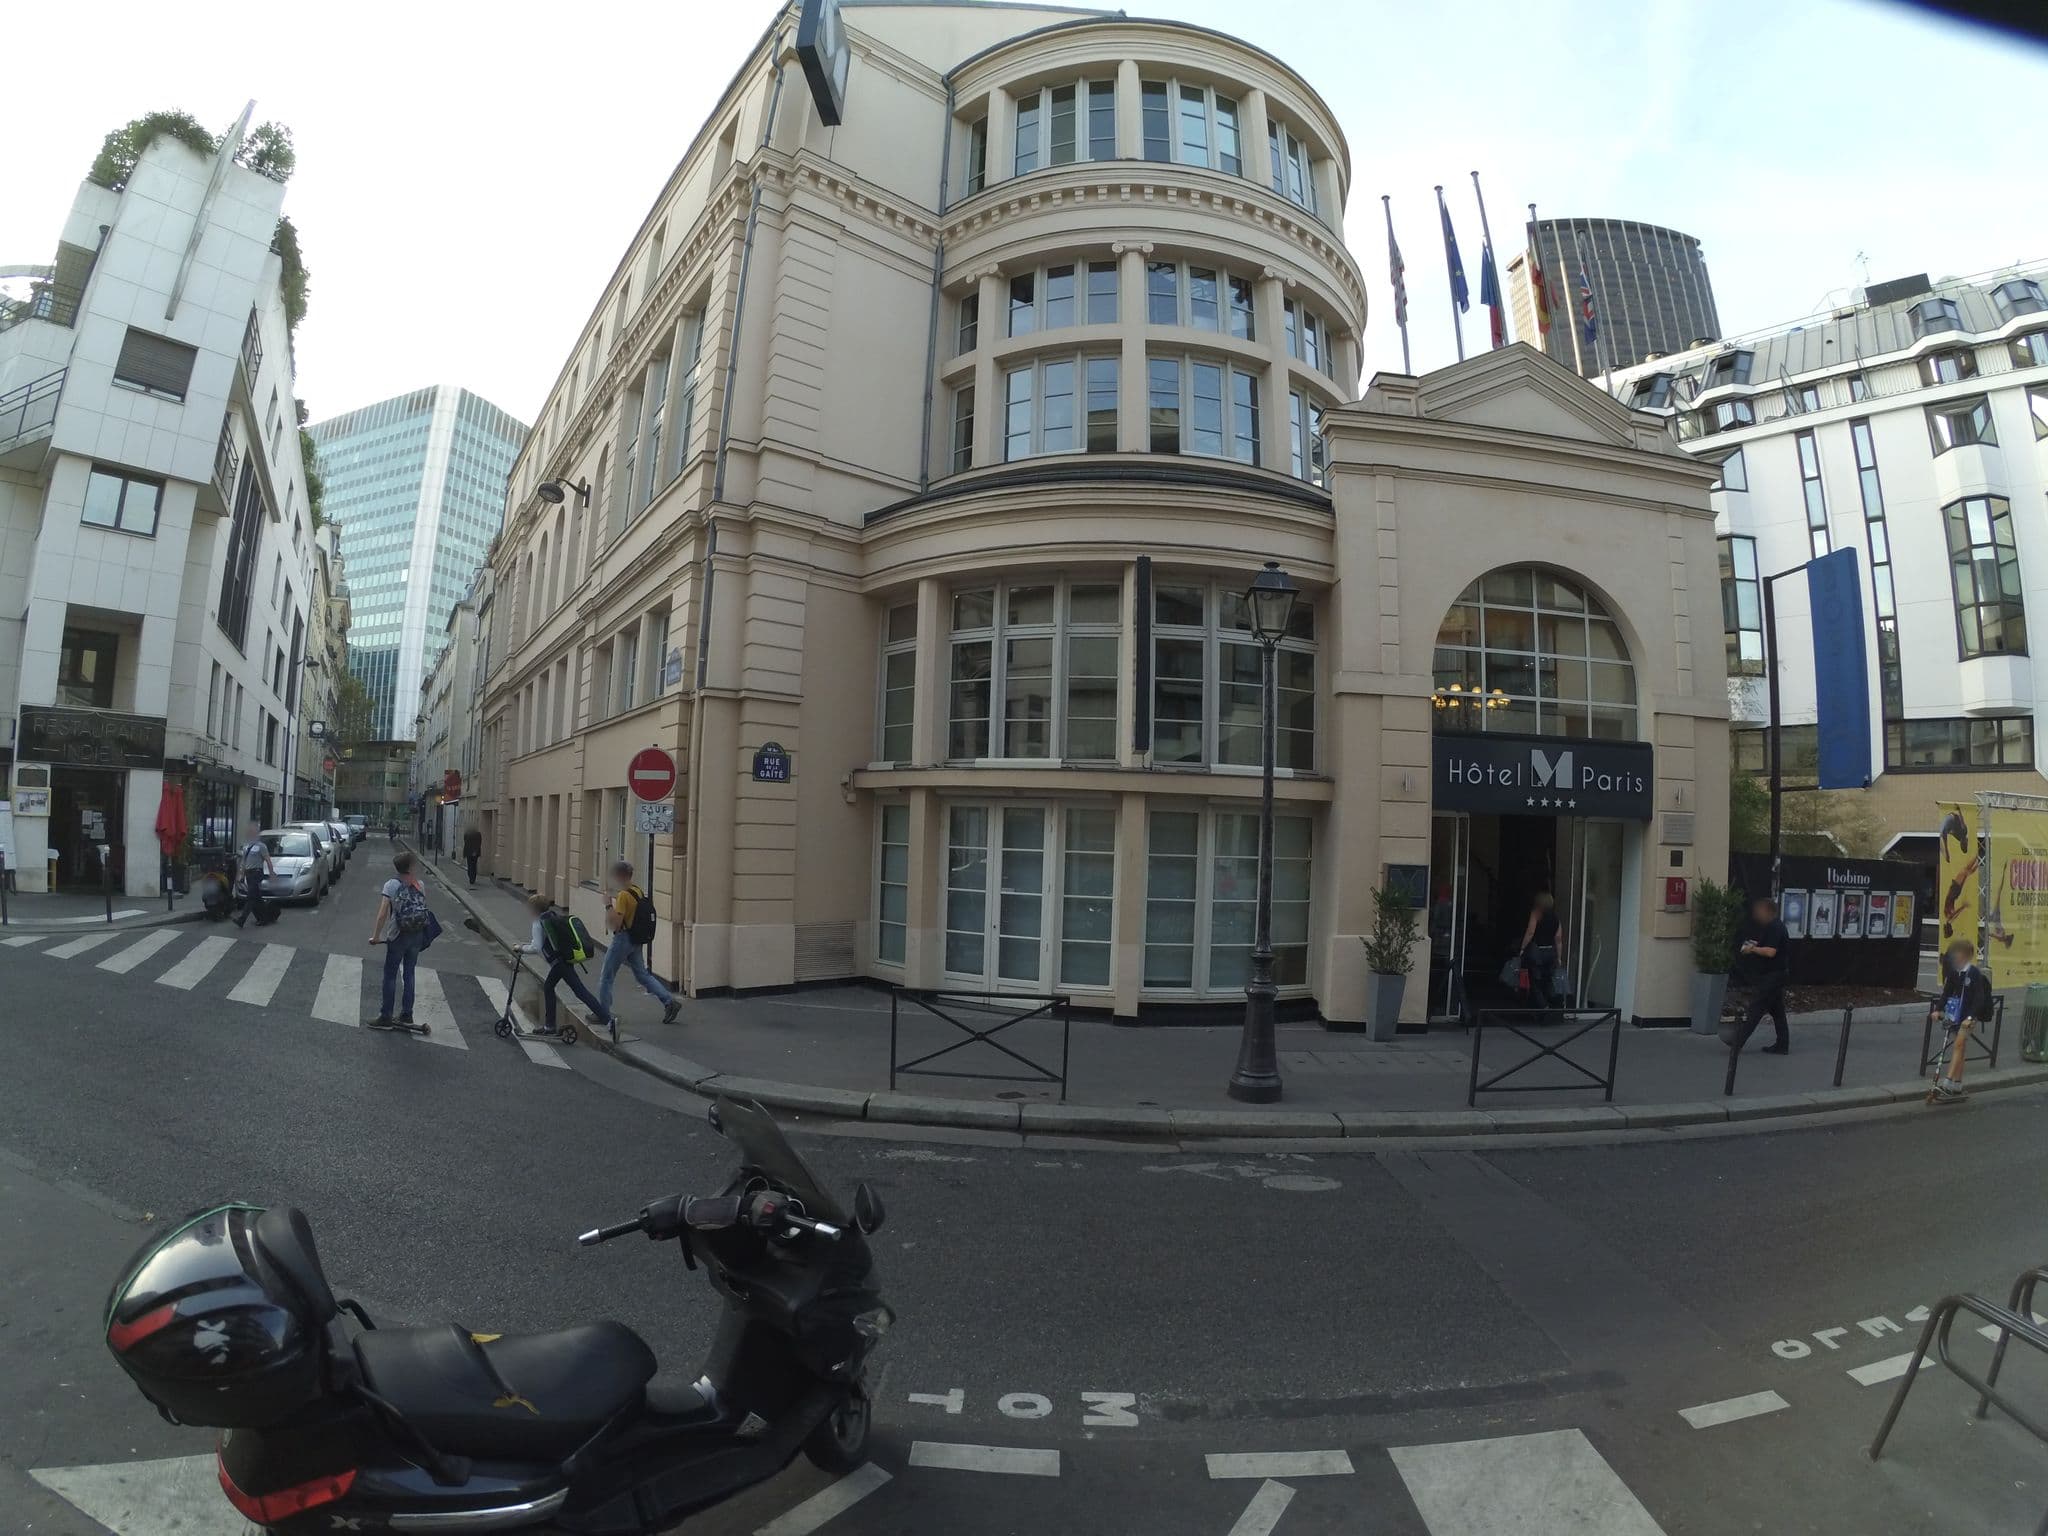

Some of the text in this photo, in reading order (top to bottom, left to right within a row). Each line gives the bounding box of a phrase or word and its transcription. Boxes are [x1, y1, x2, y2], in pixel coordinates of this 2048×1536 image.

[763, 757, 781, 766] RUE
[1448, 758, 1522, 787] Hôtel
[1582, 765, 1644, 794] Paris
[641, 805, 668, 814] SAUF
